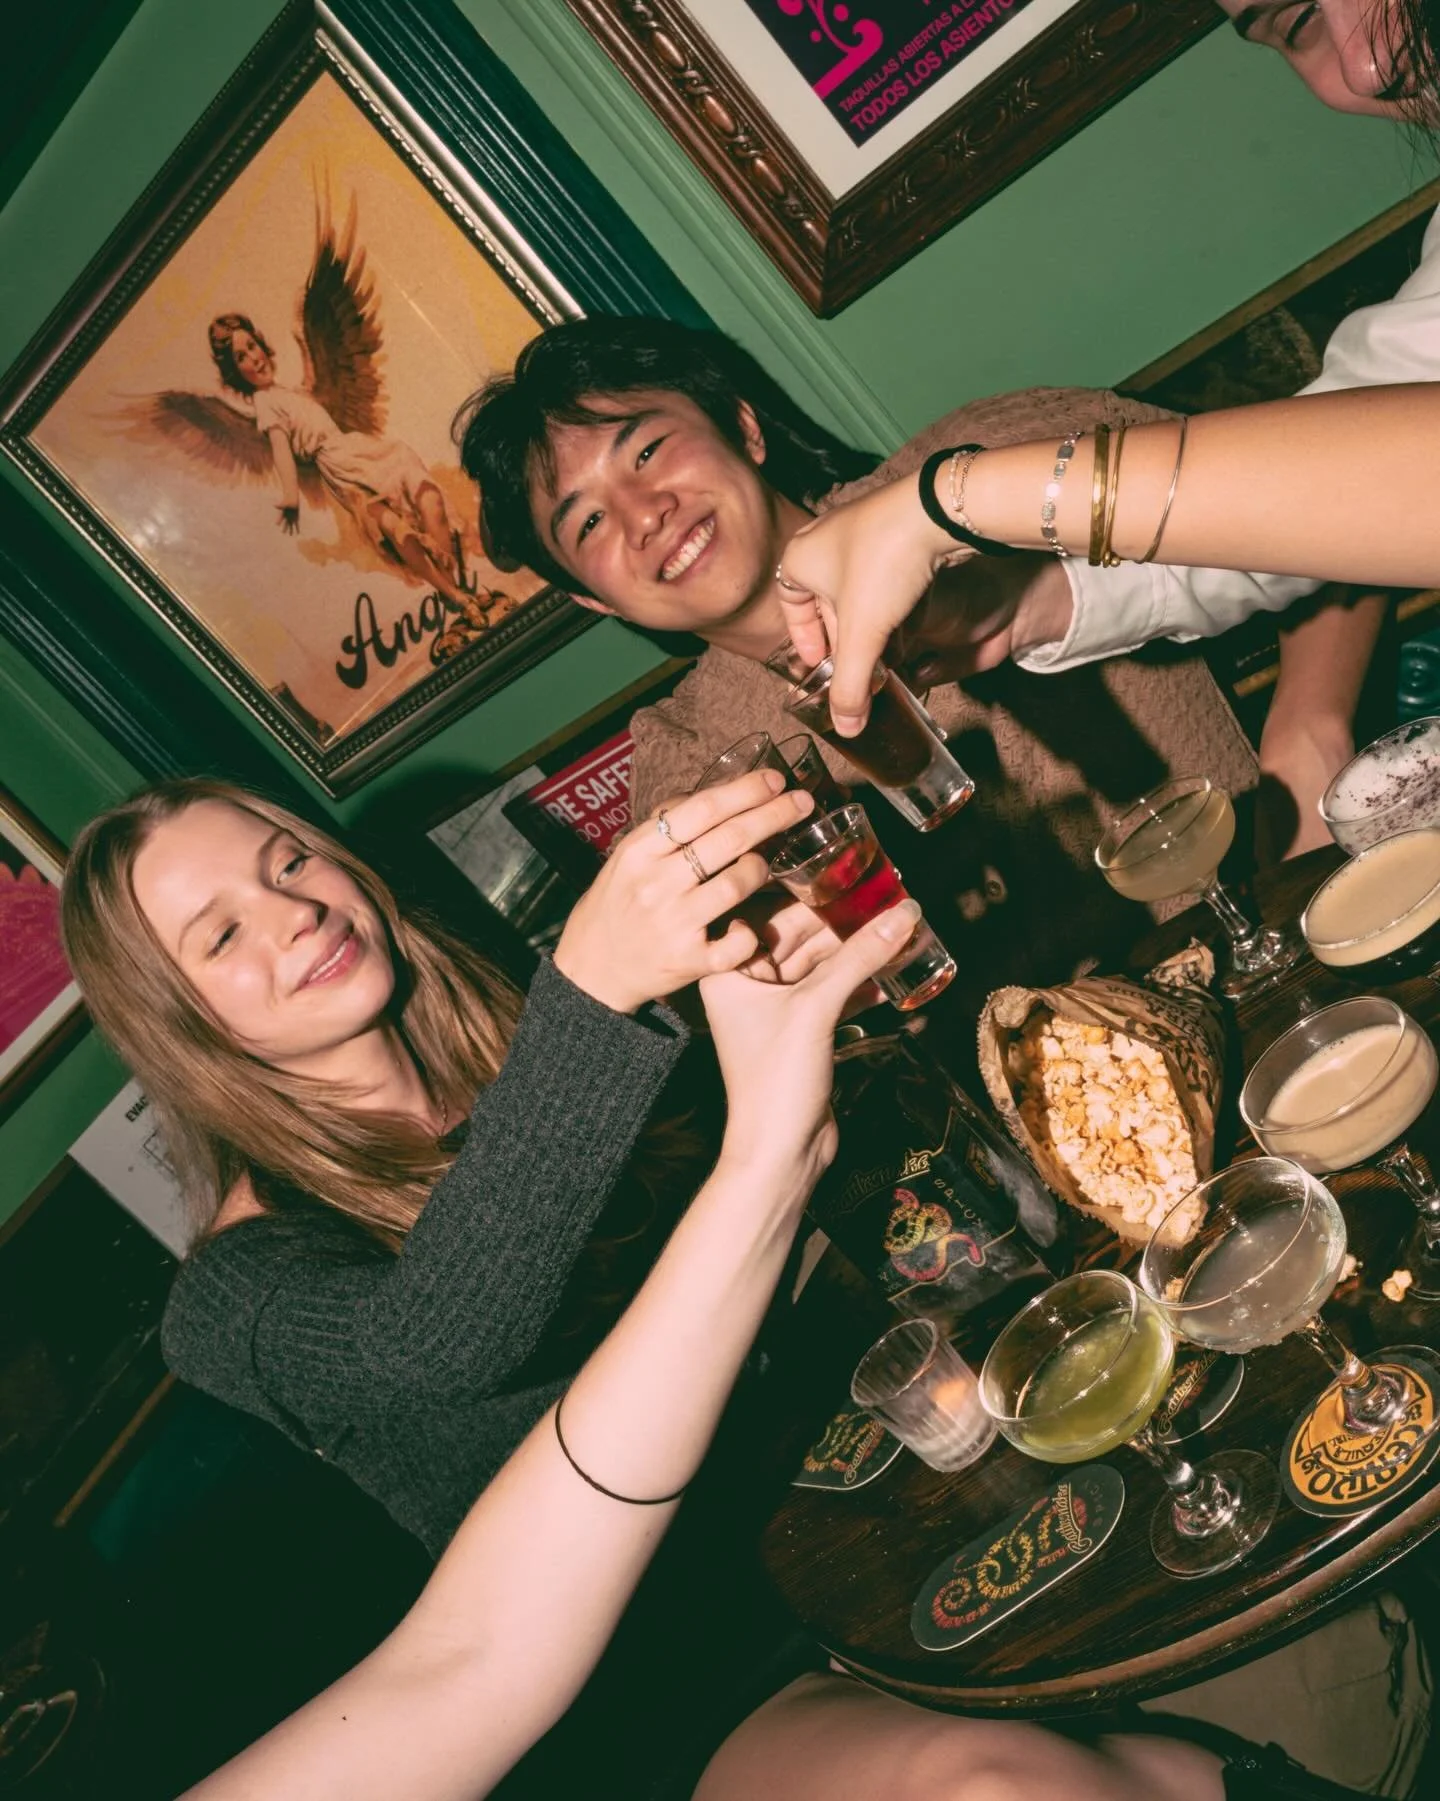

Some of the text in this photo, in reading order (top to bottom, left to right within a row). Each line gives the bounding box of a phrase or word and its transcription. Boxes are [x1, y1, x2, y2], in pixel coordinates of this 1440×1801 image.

[839, 58, 899, 112] TAQUILLAS
[897, 12, 952, 64] ABIERTAS
[851, 79, 909, 131] TODOS
[905, 50, 942, 87] LOS
[600, 801, 632, 830] NOT
